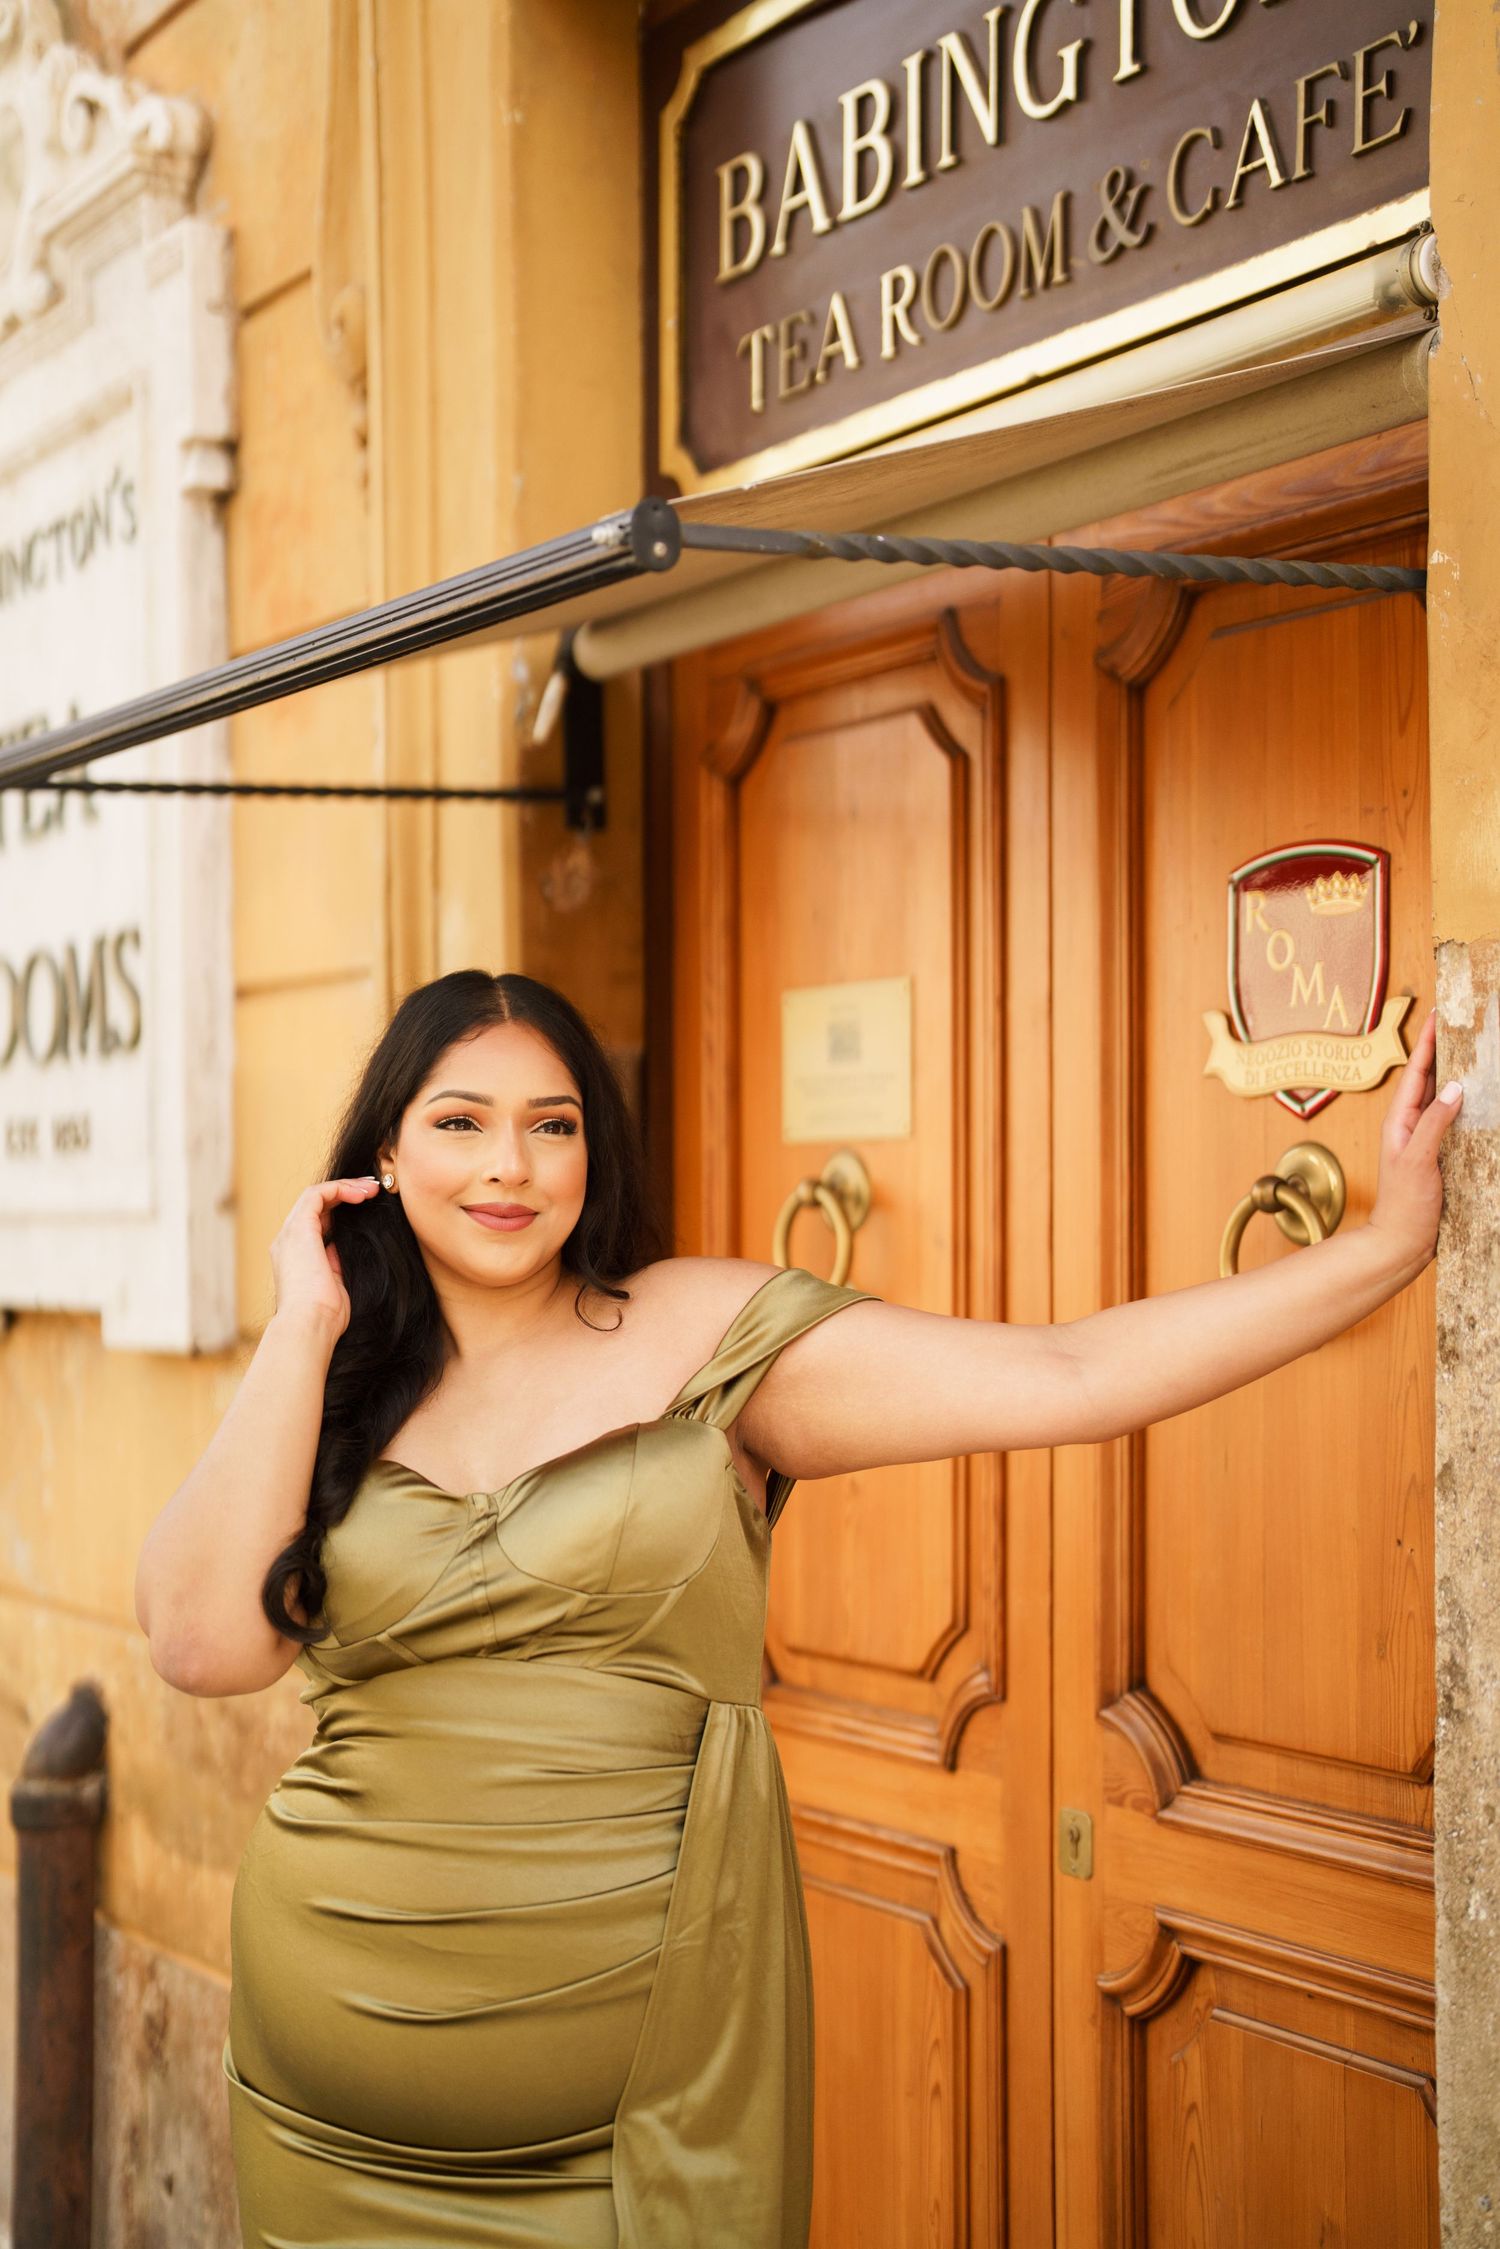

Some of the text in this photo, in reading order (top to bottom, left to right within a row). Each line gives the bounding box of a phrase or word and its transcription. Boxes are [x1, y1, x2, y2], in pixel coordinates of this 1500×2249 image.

[715, 0, 1282, 285] BABINGT
[736, 290, 861, 413] TEA
[879, 188, 1070, 360] ROOM
[1088, 166, 1157, 264] &
[1246, 889, 1350, 1030] ROMA
[1245, 1060, 1363, 1086] DI ECCELLENZA
[1305, 1039, 1373, 1062] STORICO
